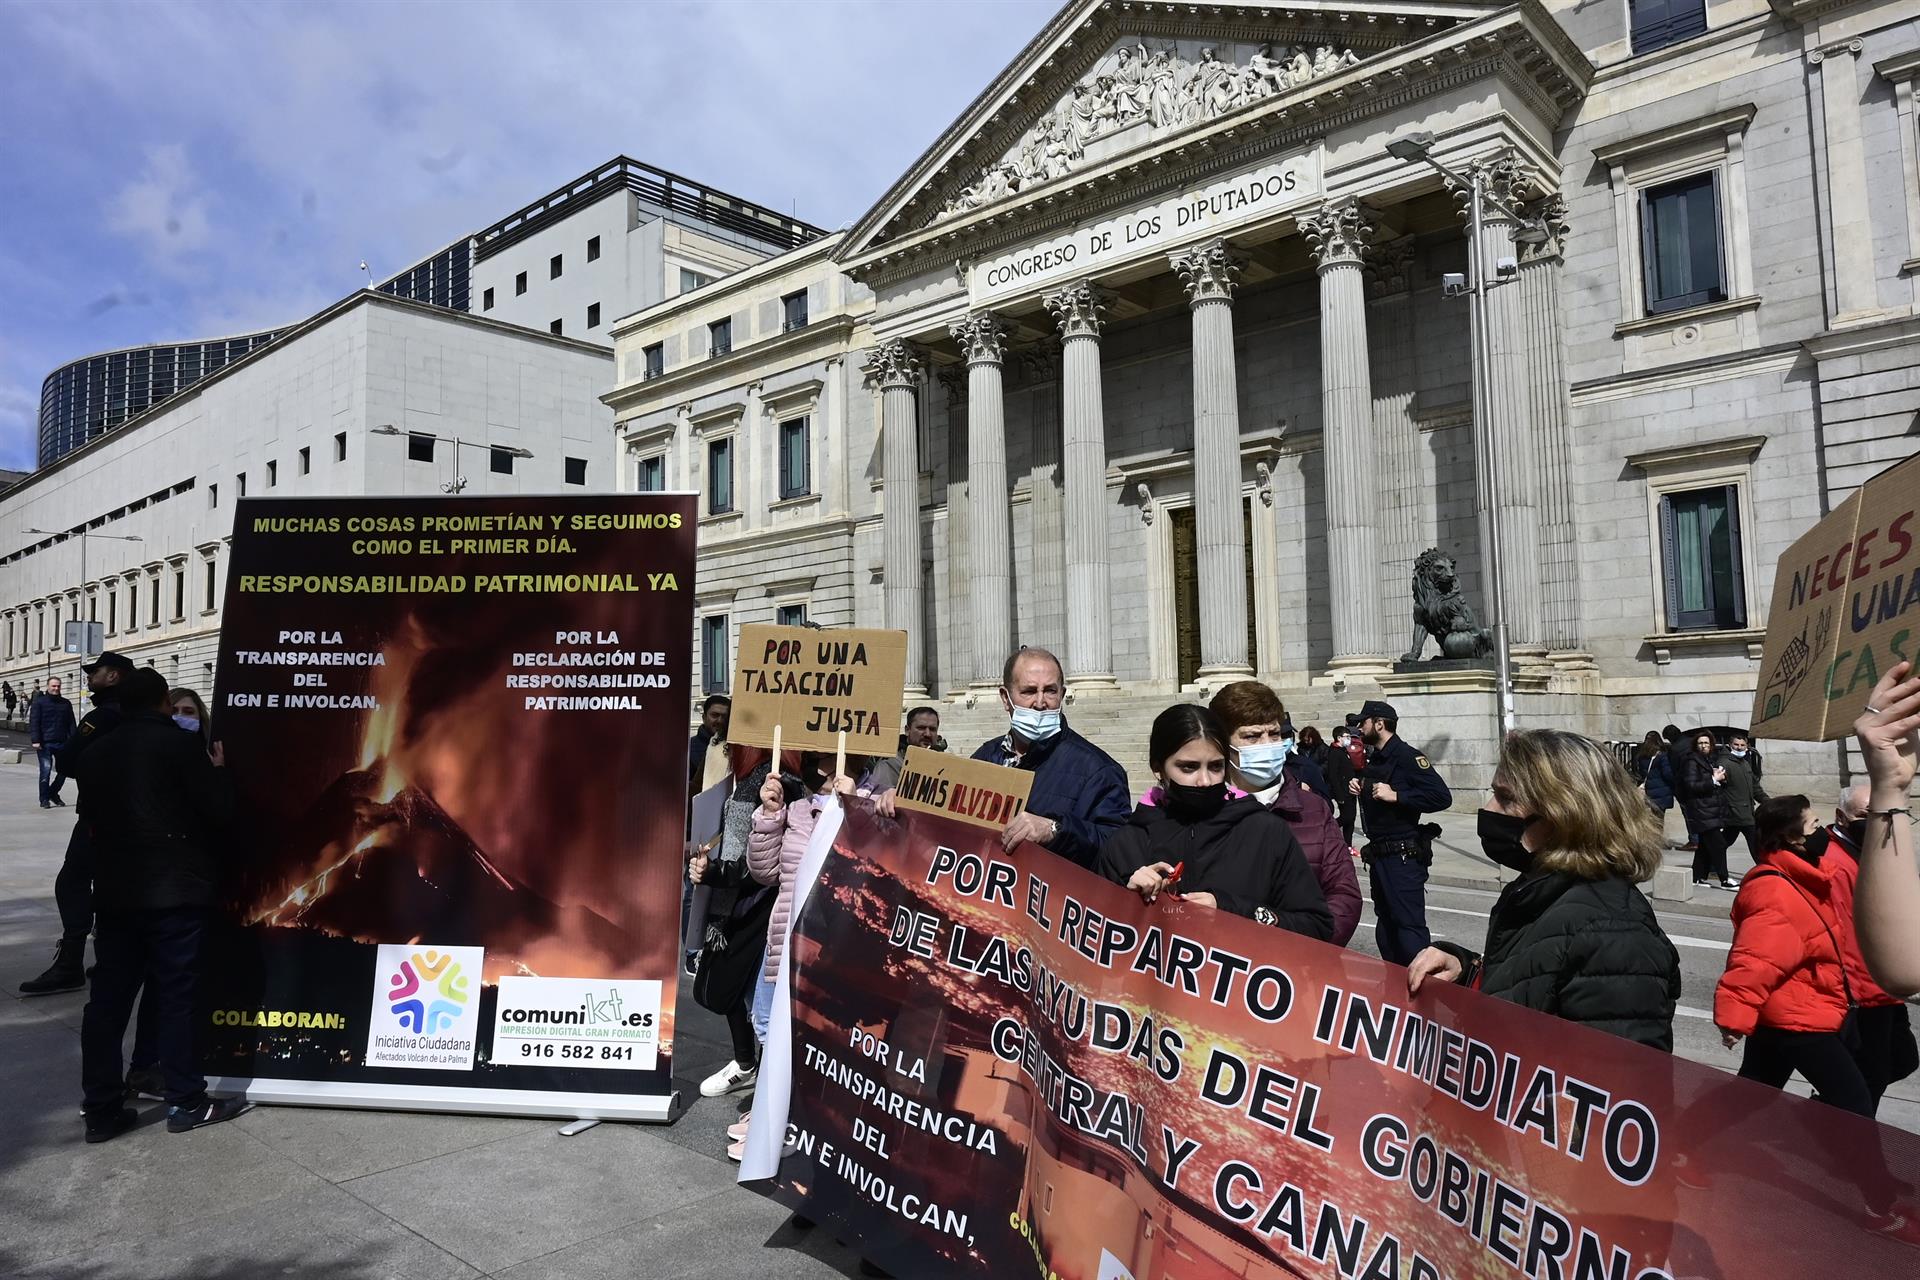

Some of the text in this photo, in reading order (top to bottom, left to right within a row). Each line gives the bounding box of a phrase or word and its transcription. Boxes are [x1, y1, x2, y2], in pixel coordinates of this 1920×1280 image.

[988, 170, 1296, 287] CONGRESO DE LOS DIPUTADOS
[253, 512, 682, 533] MUCHAS COSAS PROMETÍAN Y SEGUIMOS
[352, 535, 577, 555] COMO EL PRIMER DÍA.
[1788, 510, 1914, 611] NECES
[240, 574, 678, 594] RESPONSABILIDAD PATRIMONIAL YA
[279, 631, 343, 644] POR LA
[555, 631, 618, 645] POR LA
[236, 650, 386, 666] TRANSPARENCIA
[512, 648, 665, 667] DECLARACIÓN DE
[763, 639, 868, 666] POR UNA
[293, 673, 327, 687] DEL
[506, 674, 670, 688] RESPONSABILIDAD
[742, 667, 854, 697] TASACIÓN
[227, 694, 381, 711] IGN E INVOLCAN,
[525, 696, 641, 710] PATRIMONIAL
[806, 706, 880, 736] JUSTA
[916, 768, 949, 808] MÁS
[212, 1010, 346, 1030] COLABORAN:
[926, 846, 1660, 1187] POR EL REPARTO INMEDIATO
[500, 1025, 652, 1039] IMPRESIÓN DIGITAL GRAN FORMATO
[375, 1035, 471, 1051] Iniciativa Ciudadana
[521, 1043, 633, 1060] 916 582 841
[375, 1052, 468, 1064] Afectados Volcán de La Palma
[848, 1027, 927, 1084] POR LA
[804, 1043, 999, 1156] TRANSPARENCIA
[888, 904, 1676, 1280] DE LAS AYUDAS DEL GOBIERN
[990, 1016, 1151, 1167] CENTRAL
[1160, 1124, 1203, 1189] Y
[852, 1117, 889, 1160] DEL
[819, 1141, 834, 1168] E
[837, 1153, 976, 1247] INVOLCAN,
